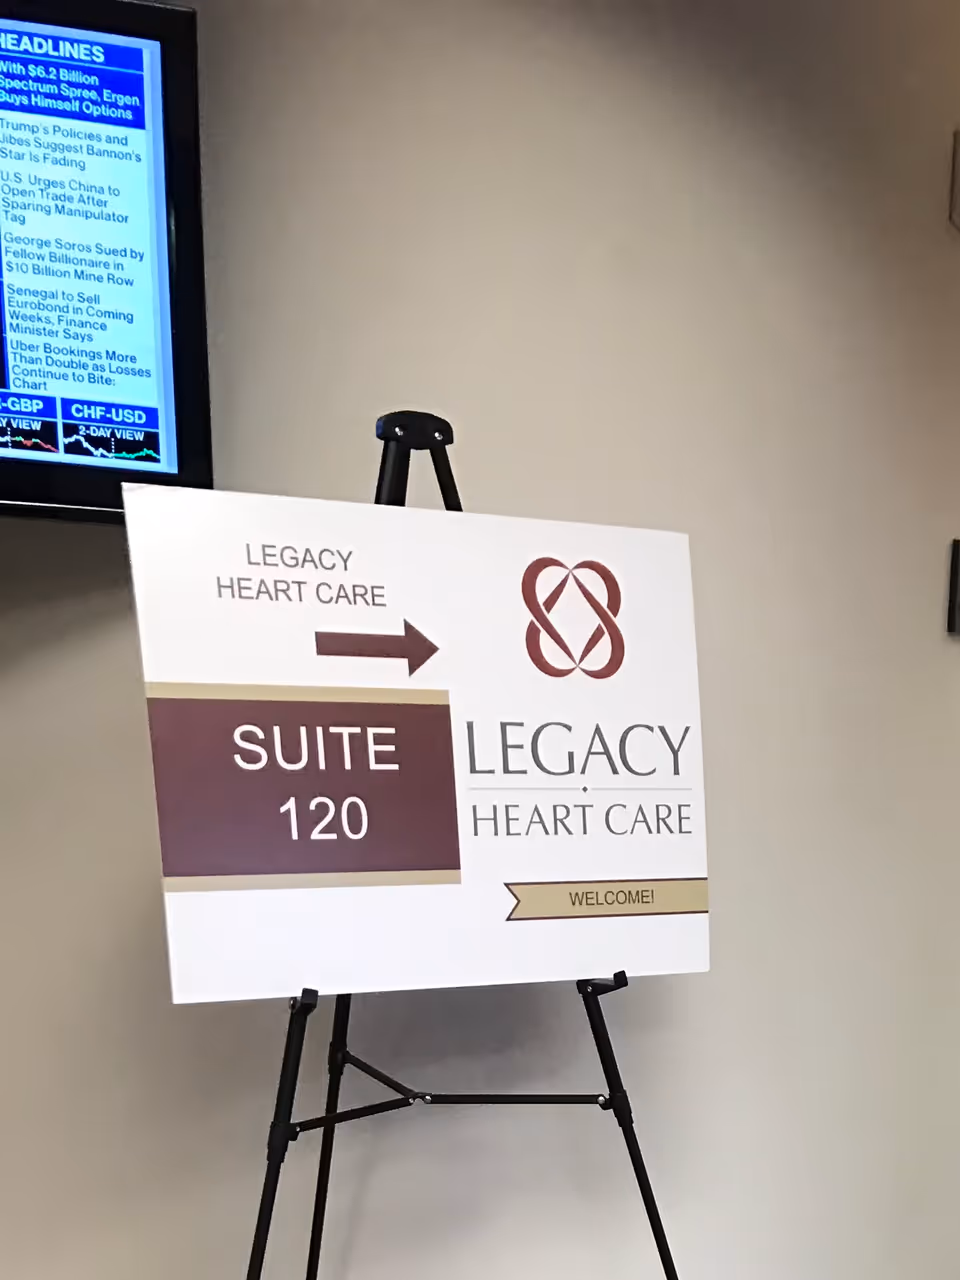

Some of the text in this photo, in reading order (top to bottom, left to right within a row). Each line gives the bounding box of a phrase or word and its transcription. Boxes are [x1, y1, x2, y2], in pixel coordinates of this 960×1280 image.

[28, 64, 57, 80] $6.2
[60, 68, 99, 85] Billion
[0, 75, 140, 106] Spectrum Spree, Ergen
[0, 89, 133, 119] Buys Himself Options
[0, 118, 128, 146] Trump's Policies and
[0, 133, 142, 162] Jibes Suggest Bannon's
[0, 147, 86, 171] Star Is Fading
[1, 184, 108, 208] Open Trade After
[28, 174, 65, 189] Urges
[69, 179, 104, 195] China
[108, 185, 120, 197] to
[2, 197, 129, 223] Sparing Manipulator
[3, 210, 25, 225] Tag
[4, 232, 144, 262] George Soros Sued by
[5, 246, 124, 271] Fellow Billionaire in
[6, 260, 134, 286] $10 Billion Mine Row
[7, 283, 100, 304] Senegal to Sell
[8, 296, 134, 324] Eurobond in Coming
[8, 309, 107, 331] Weeks, Finance
[9, 322, 93, 343] Minister Says
[10, 339, 137, 363] Uber Bookings More
[11, 352, 152, 378] Than Double as Losses
[12, 365, 115, 386] Continue to Bite:
[12, 378, 48, 391] Chart
[10, 417, 42, 431] VIEW
[71, 403, 147, 424] CHF-USD
[79, 425, 145, 441] 2-DAY VIEW
[245, 543, 354, 572] LEGACY
[216, 576, 387, 607] HEART CARE
[233, 724, 400, 772] SUITE
[466, 721, 691, 777] LEGACY
[279, 796, 369, 840] 120
[472, 803, 693, 837] HEART CARE
[569, 889, 655, 907] WELCOME!
